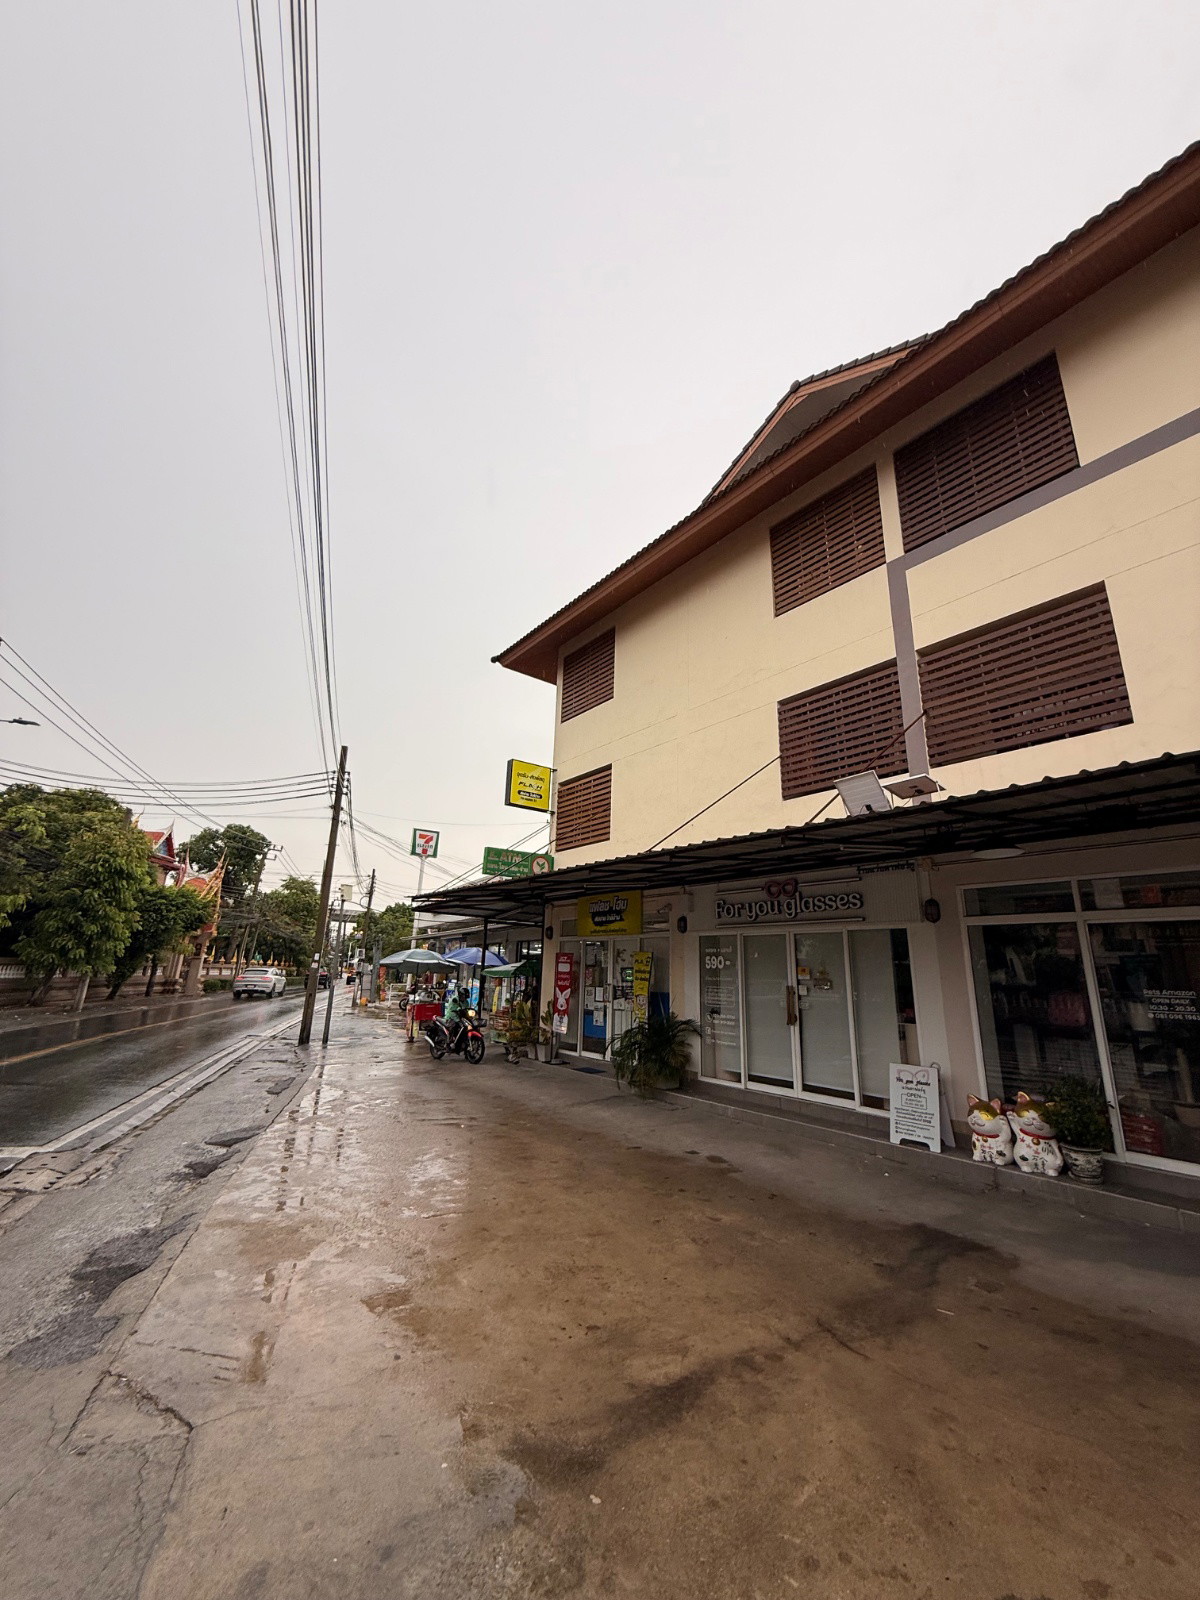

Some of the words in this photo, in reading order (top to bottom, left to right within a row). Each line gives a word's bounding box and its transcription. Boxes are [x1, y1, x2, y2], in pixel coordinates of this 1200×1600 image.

[419, 833, 434, 854] 7
[500, 852, 522, 863] ATM
[714, 900, 742, 919] For
[745, 899, 779, 920] you
[783, 891, 862, 918] glasses
